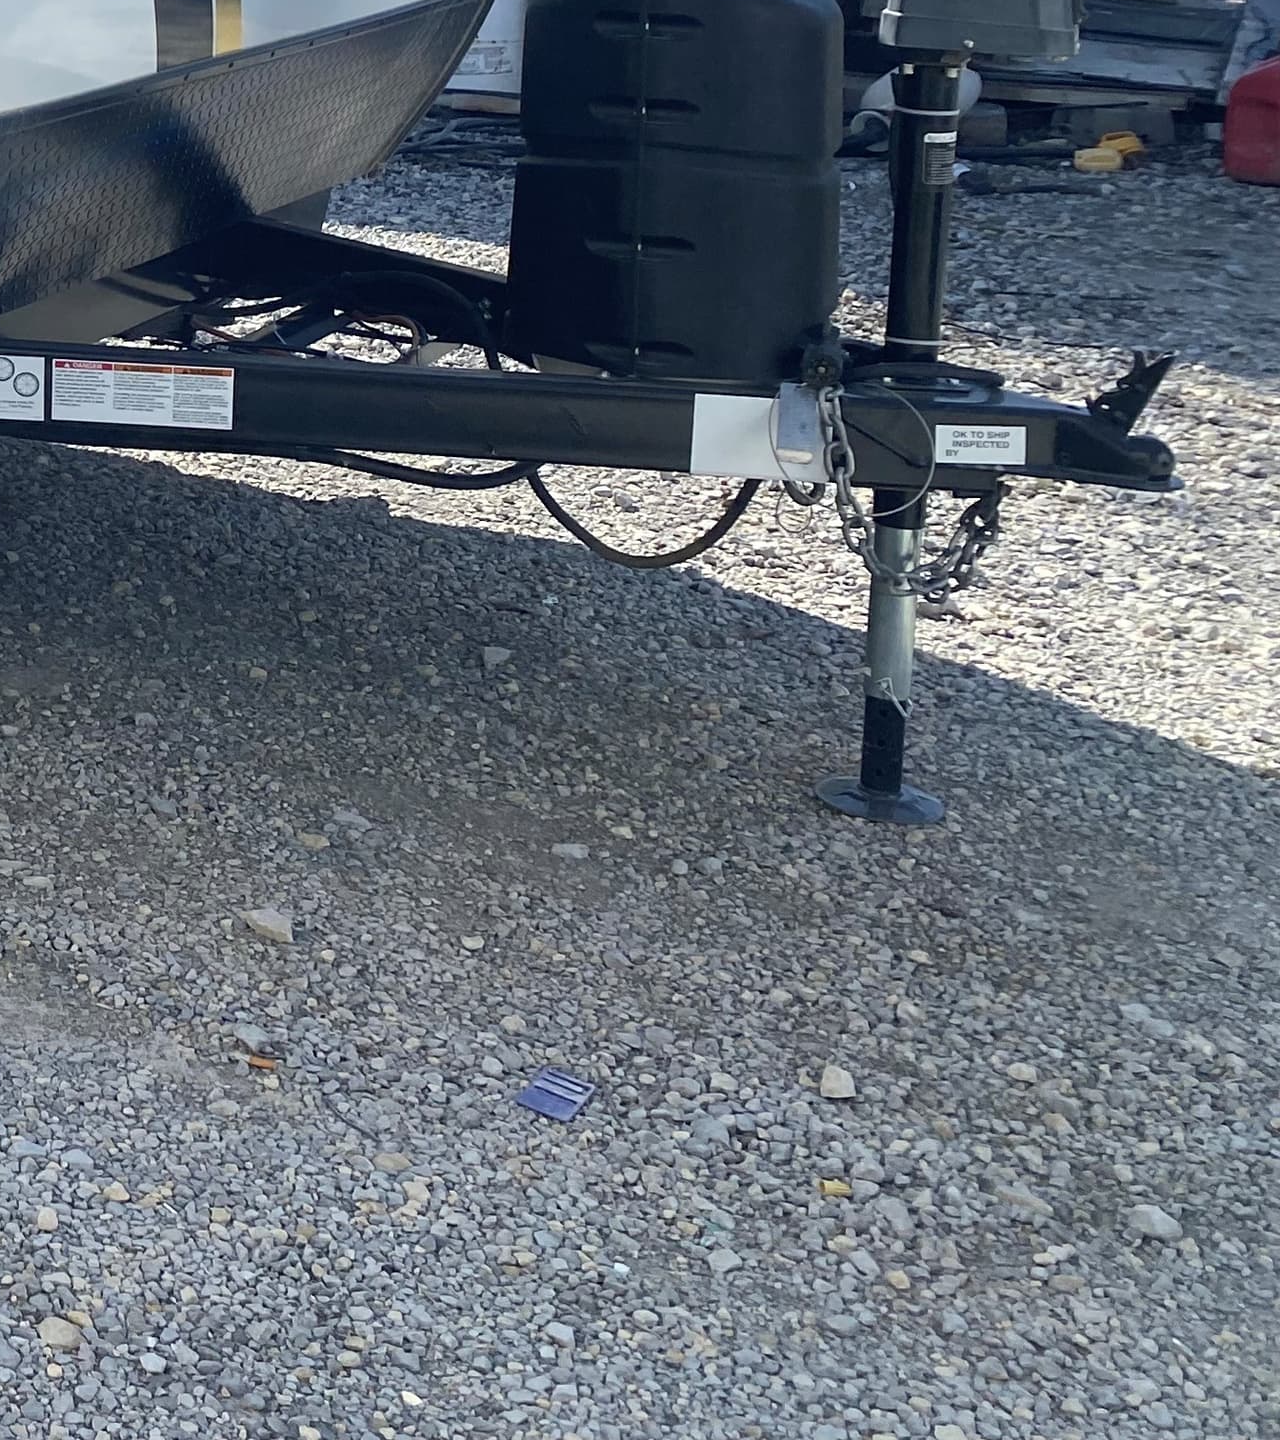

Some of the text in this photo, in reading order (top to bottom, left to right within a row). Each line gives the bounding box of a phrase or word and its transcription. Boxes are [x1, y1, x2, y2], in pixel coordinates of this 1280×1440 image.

[952, 430, 1011, 439] OK TO SHIP
[951, 440, 1010, 449] INSPECTED
[945, 449, 959, 457] BY
